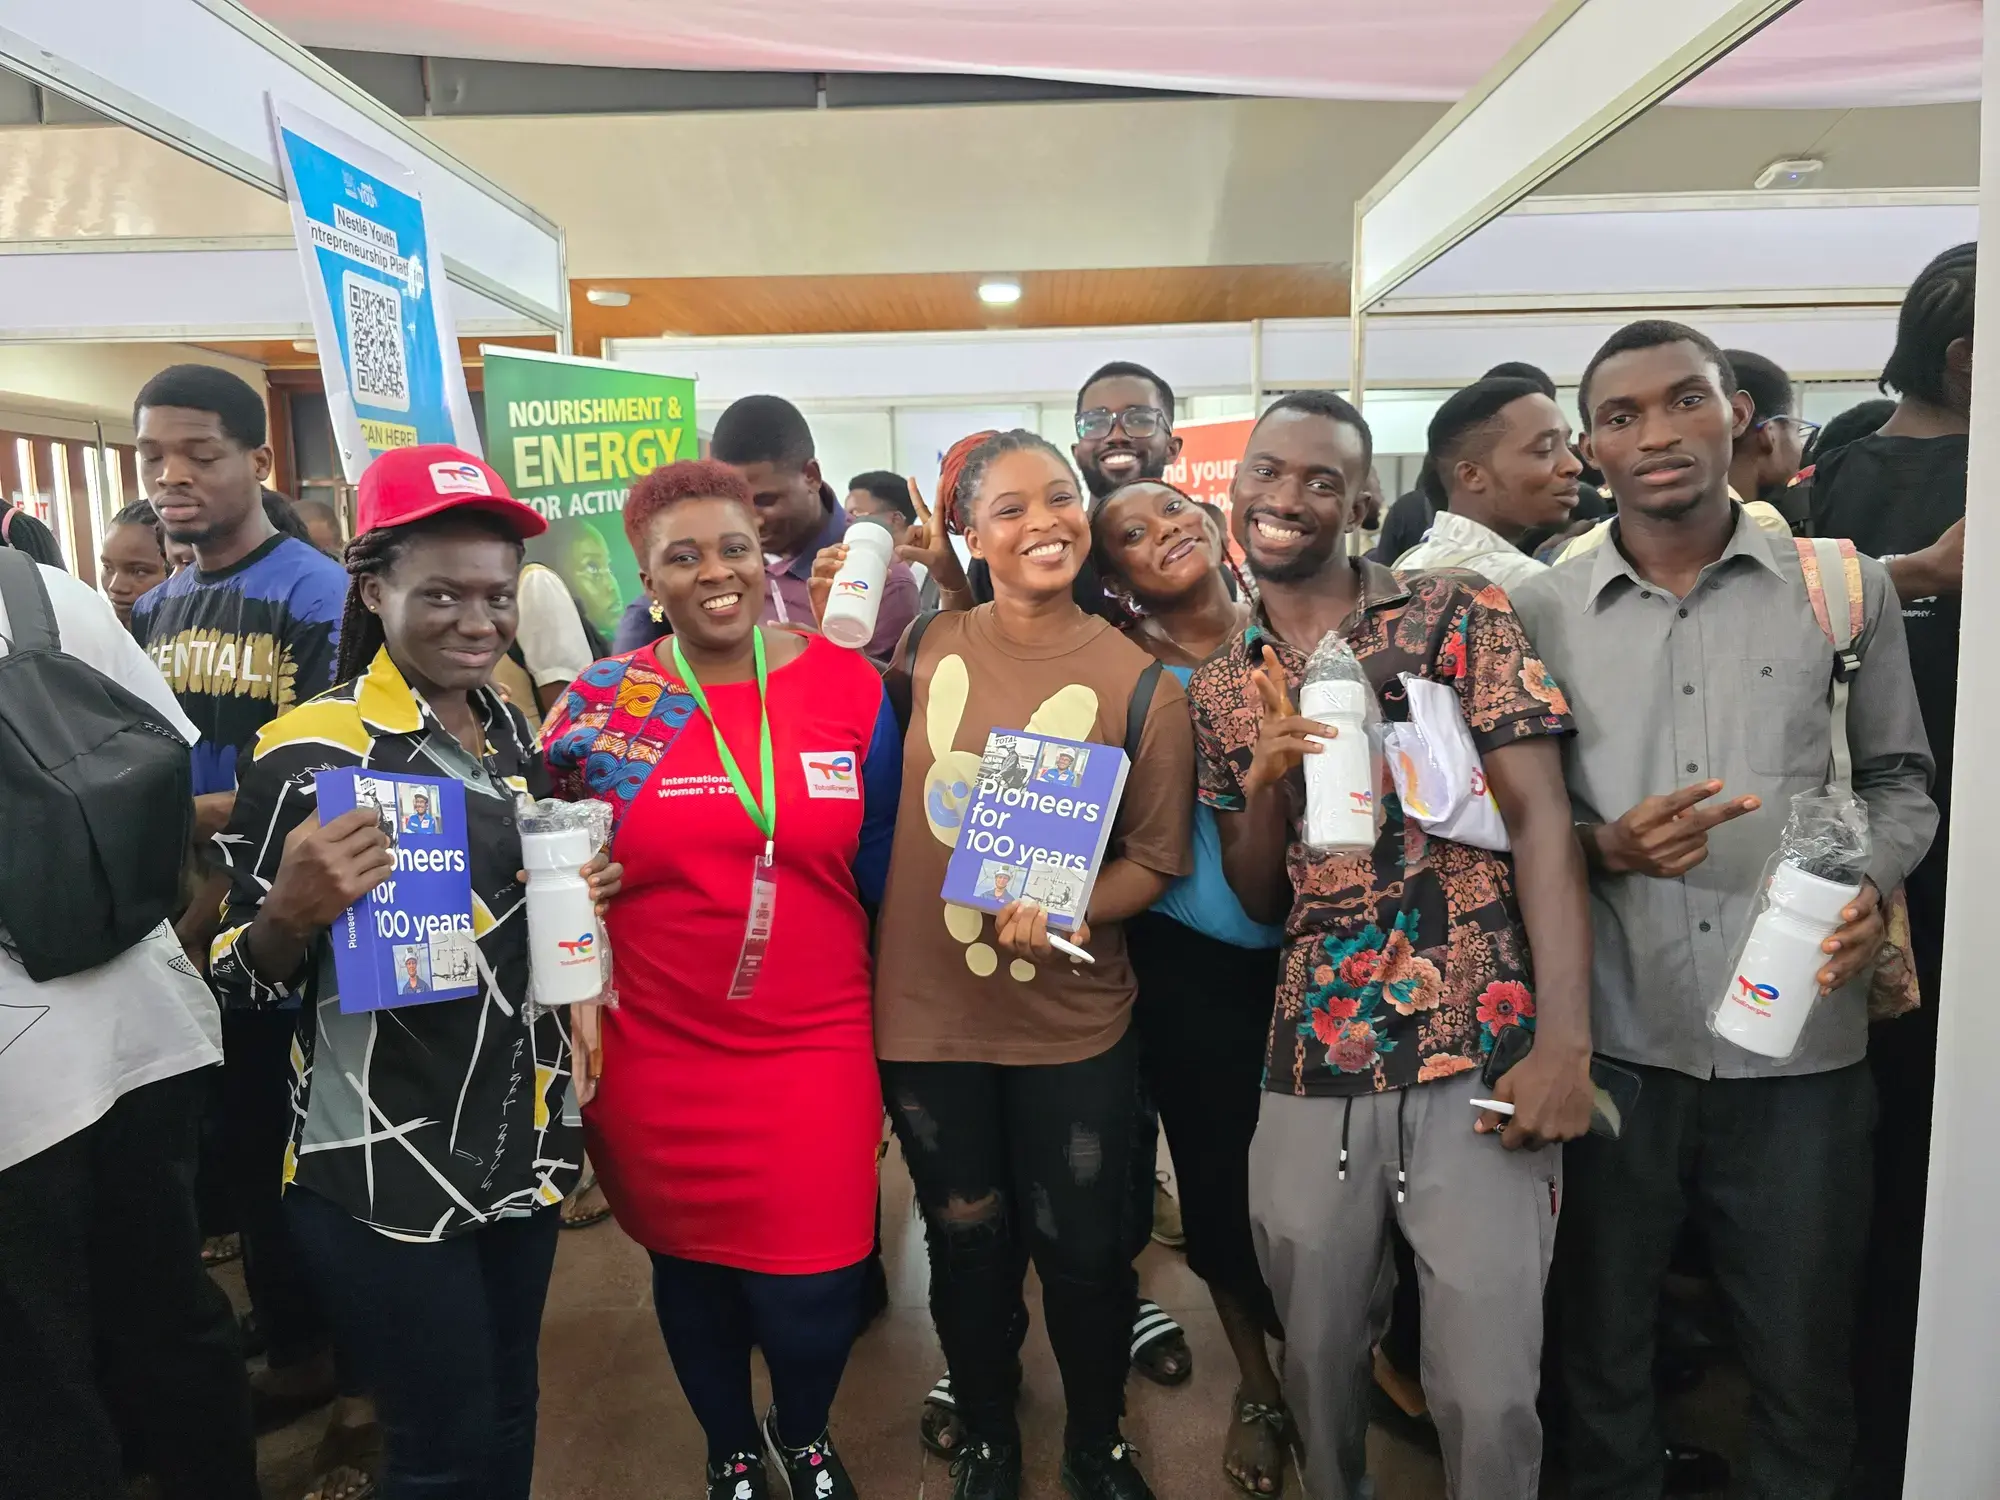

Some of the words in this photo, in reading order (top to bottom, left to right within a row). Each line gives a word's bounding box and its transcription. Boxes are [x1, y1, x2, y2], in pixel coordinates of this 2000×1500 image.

[337, 208, 368, 236] Nestlé
[368, 224, 396, 249] Youth
[308, 221, 388, 272] ntrepreneurship
[508, 397, 663, 428] NOURISHMENT
[667, 396, 682, 420] &
[386, 428, 416, 447] HERE!
[513, 427, 683, 489] ENERGY
[1162, 456, 1187, 484] nd
[1191, 459, 1238, 489] your
[568, 488, 631, 517] ACTIV
[1901, 610, 1930, 618] RAPHY
[661, 775, 732, 786] Internationa
[970, 802, 1011, 830] for
[977, 777, 1100, 823] Pioneers
[385, 848, 466, 872] oneers
[966, 829, 1014, 858] 100
[1016, 843, 1087, 873] years
[346, 906, 358, 949] Pioneers
[374, 910, 410, 939] 100
[412, 913, 471, 942] years
